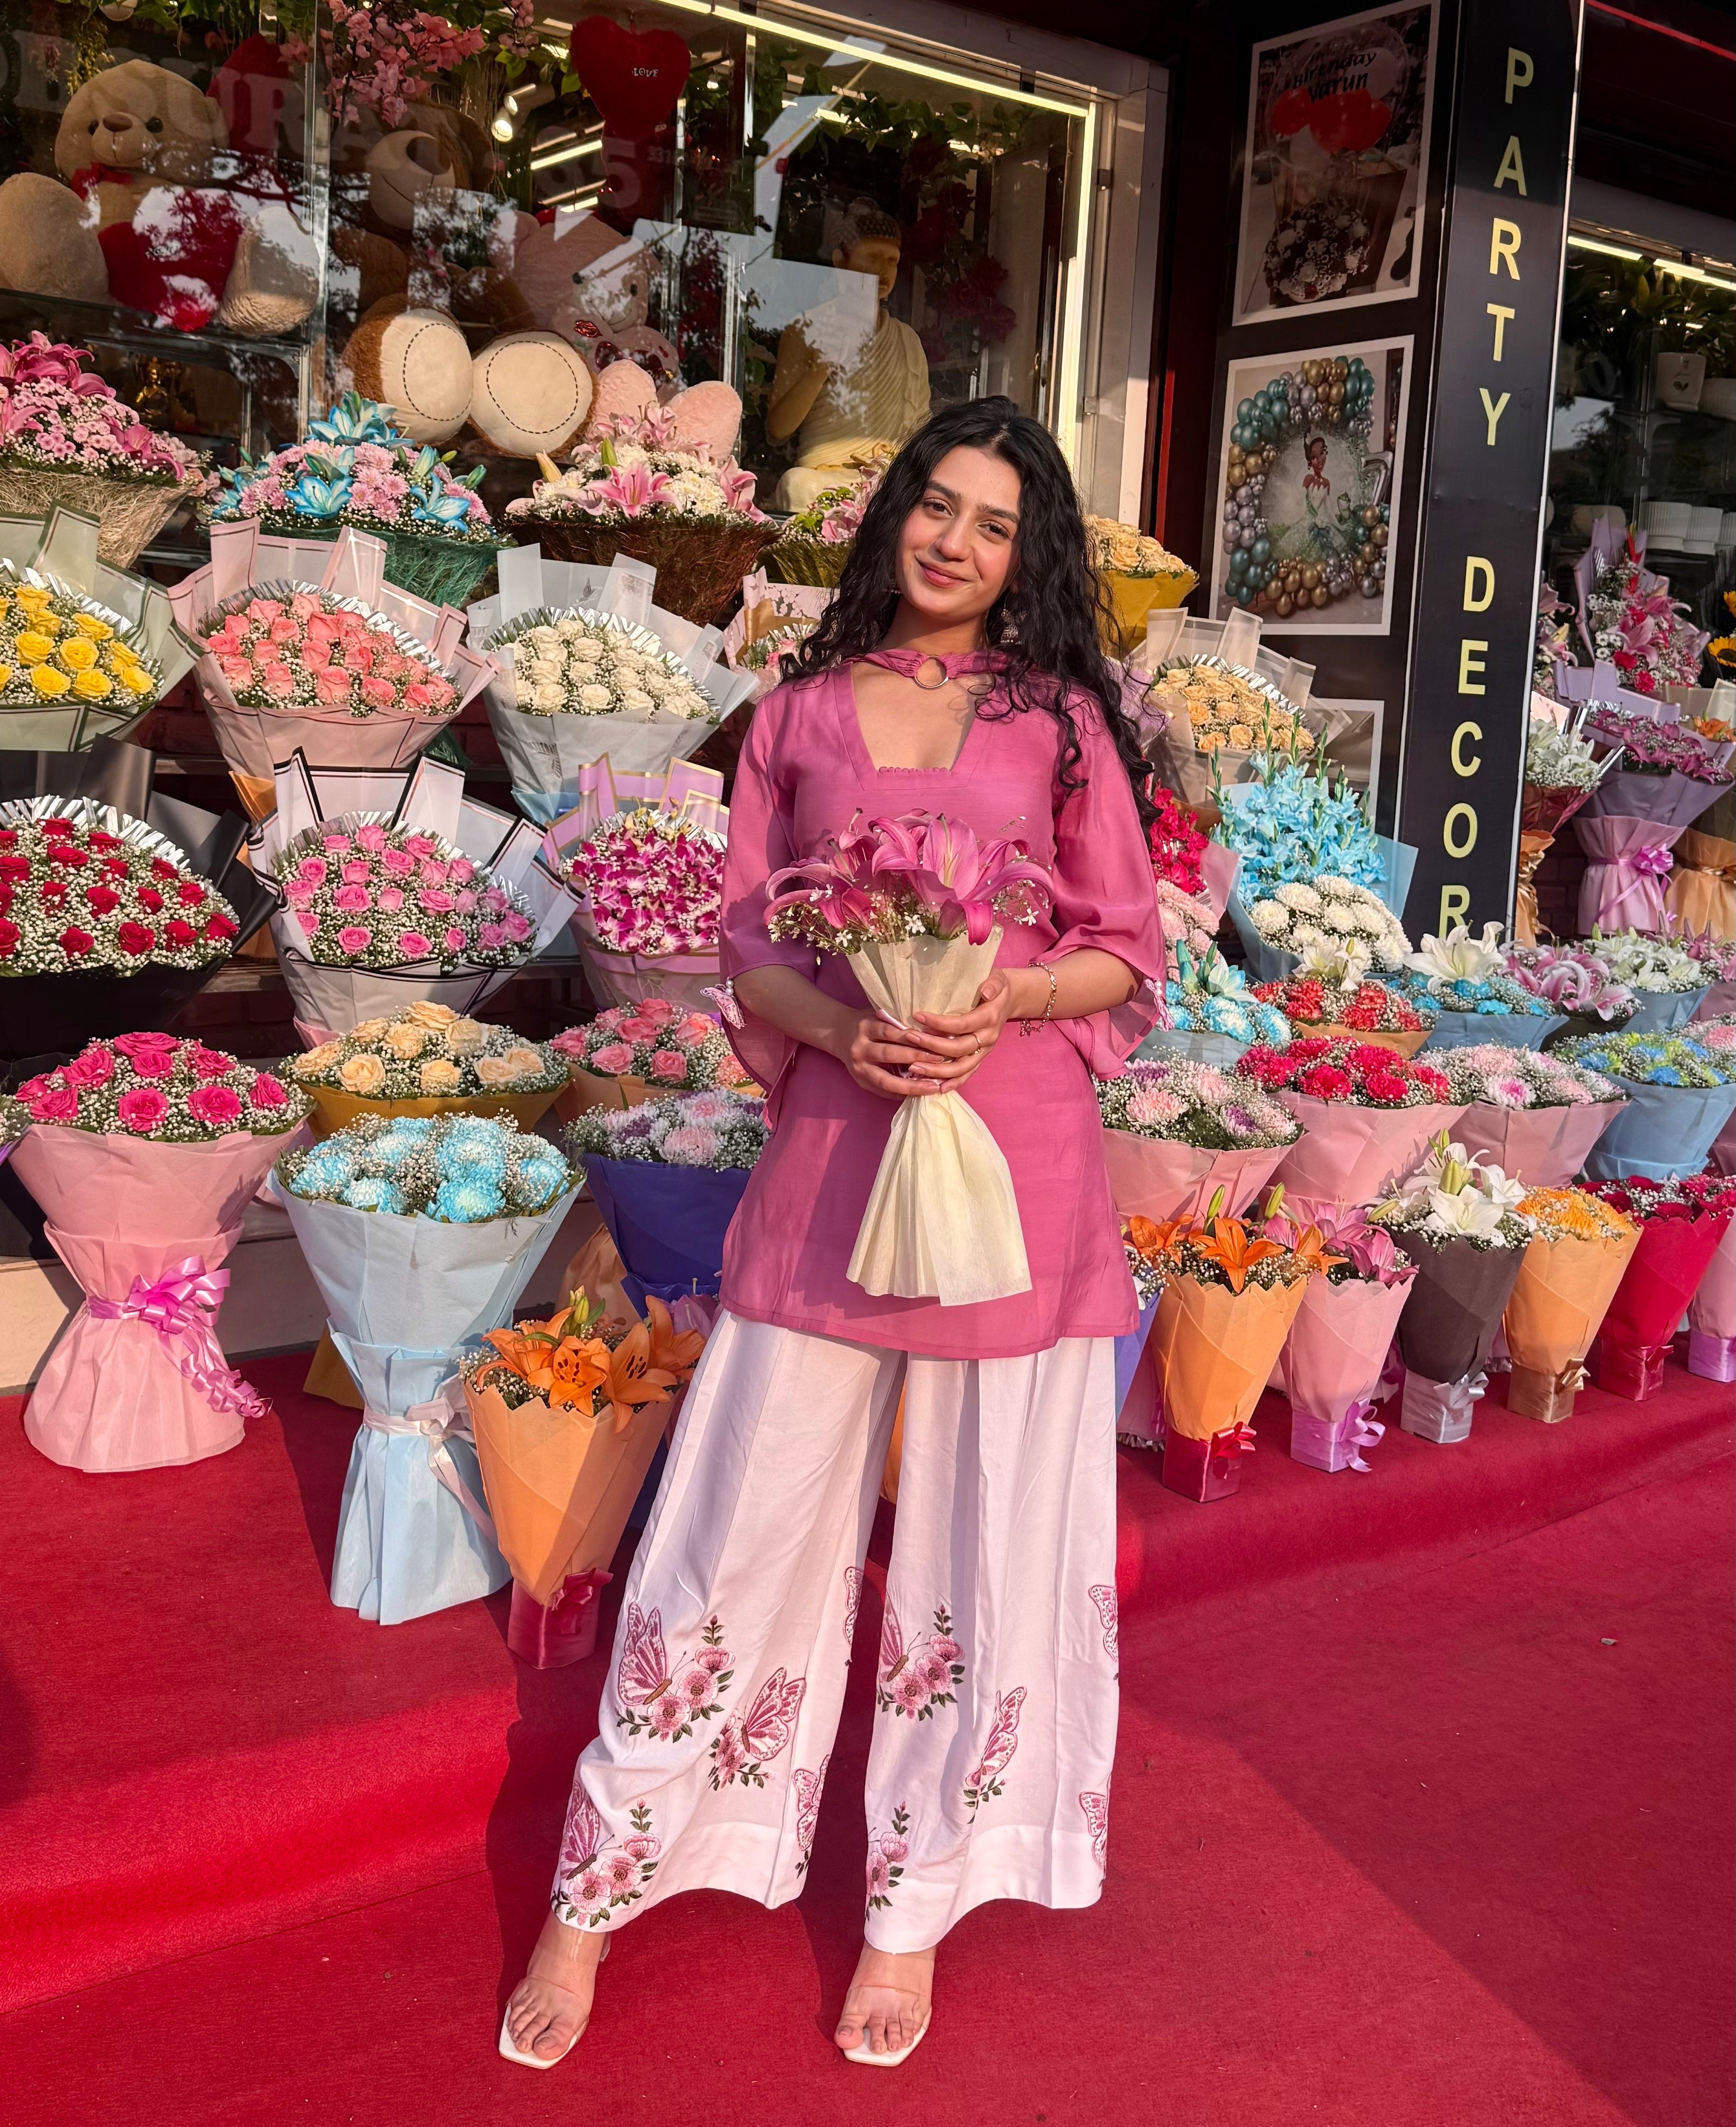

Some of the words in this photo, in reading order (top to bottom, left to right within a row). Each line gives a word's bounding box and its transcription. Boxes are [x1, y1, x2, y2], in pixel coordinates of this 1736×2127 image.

[633, 67, 659, 78] LOVE
[1480, 47, 1534, 446] PARTY
[1439, 556, 1495, 940] DECOR
